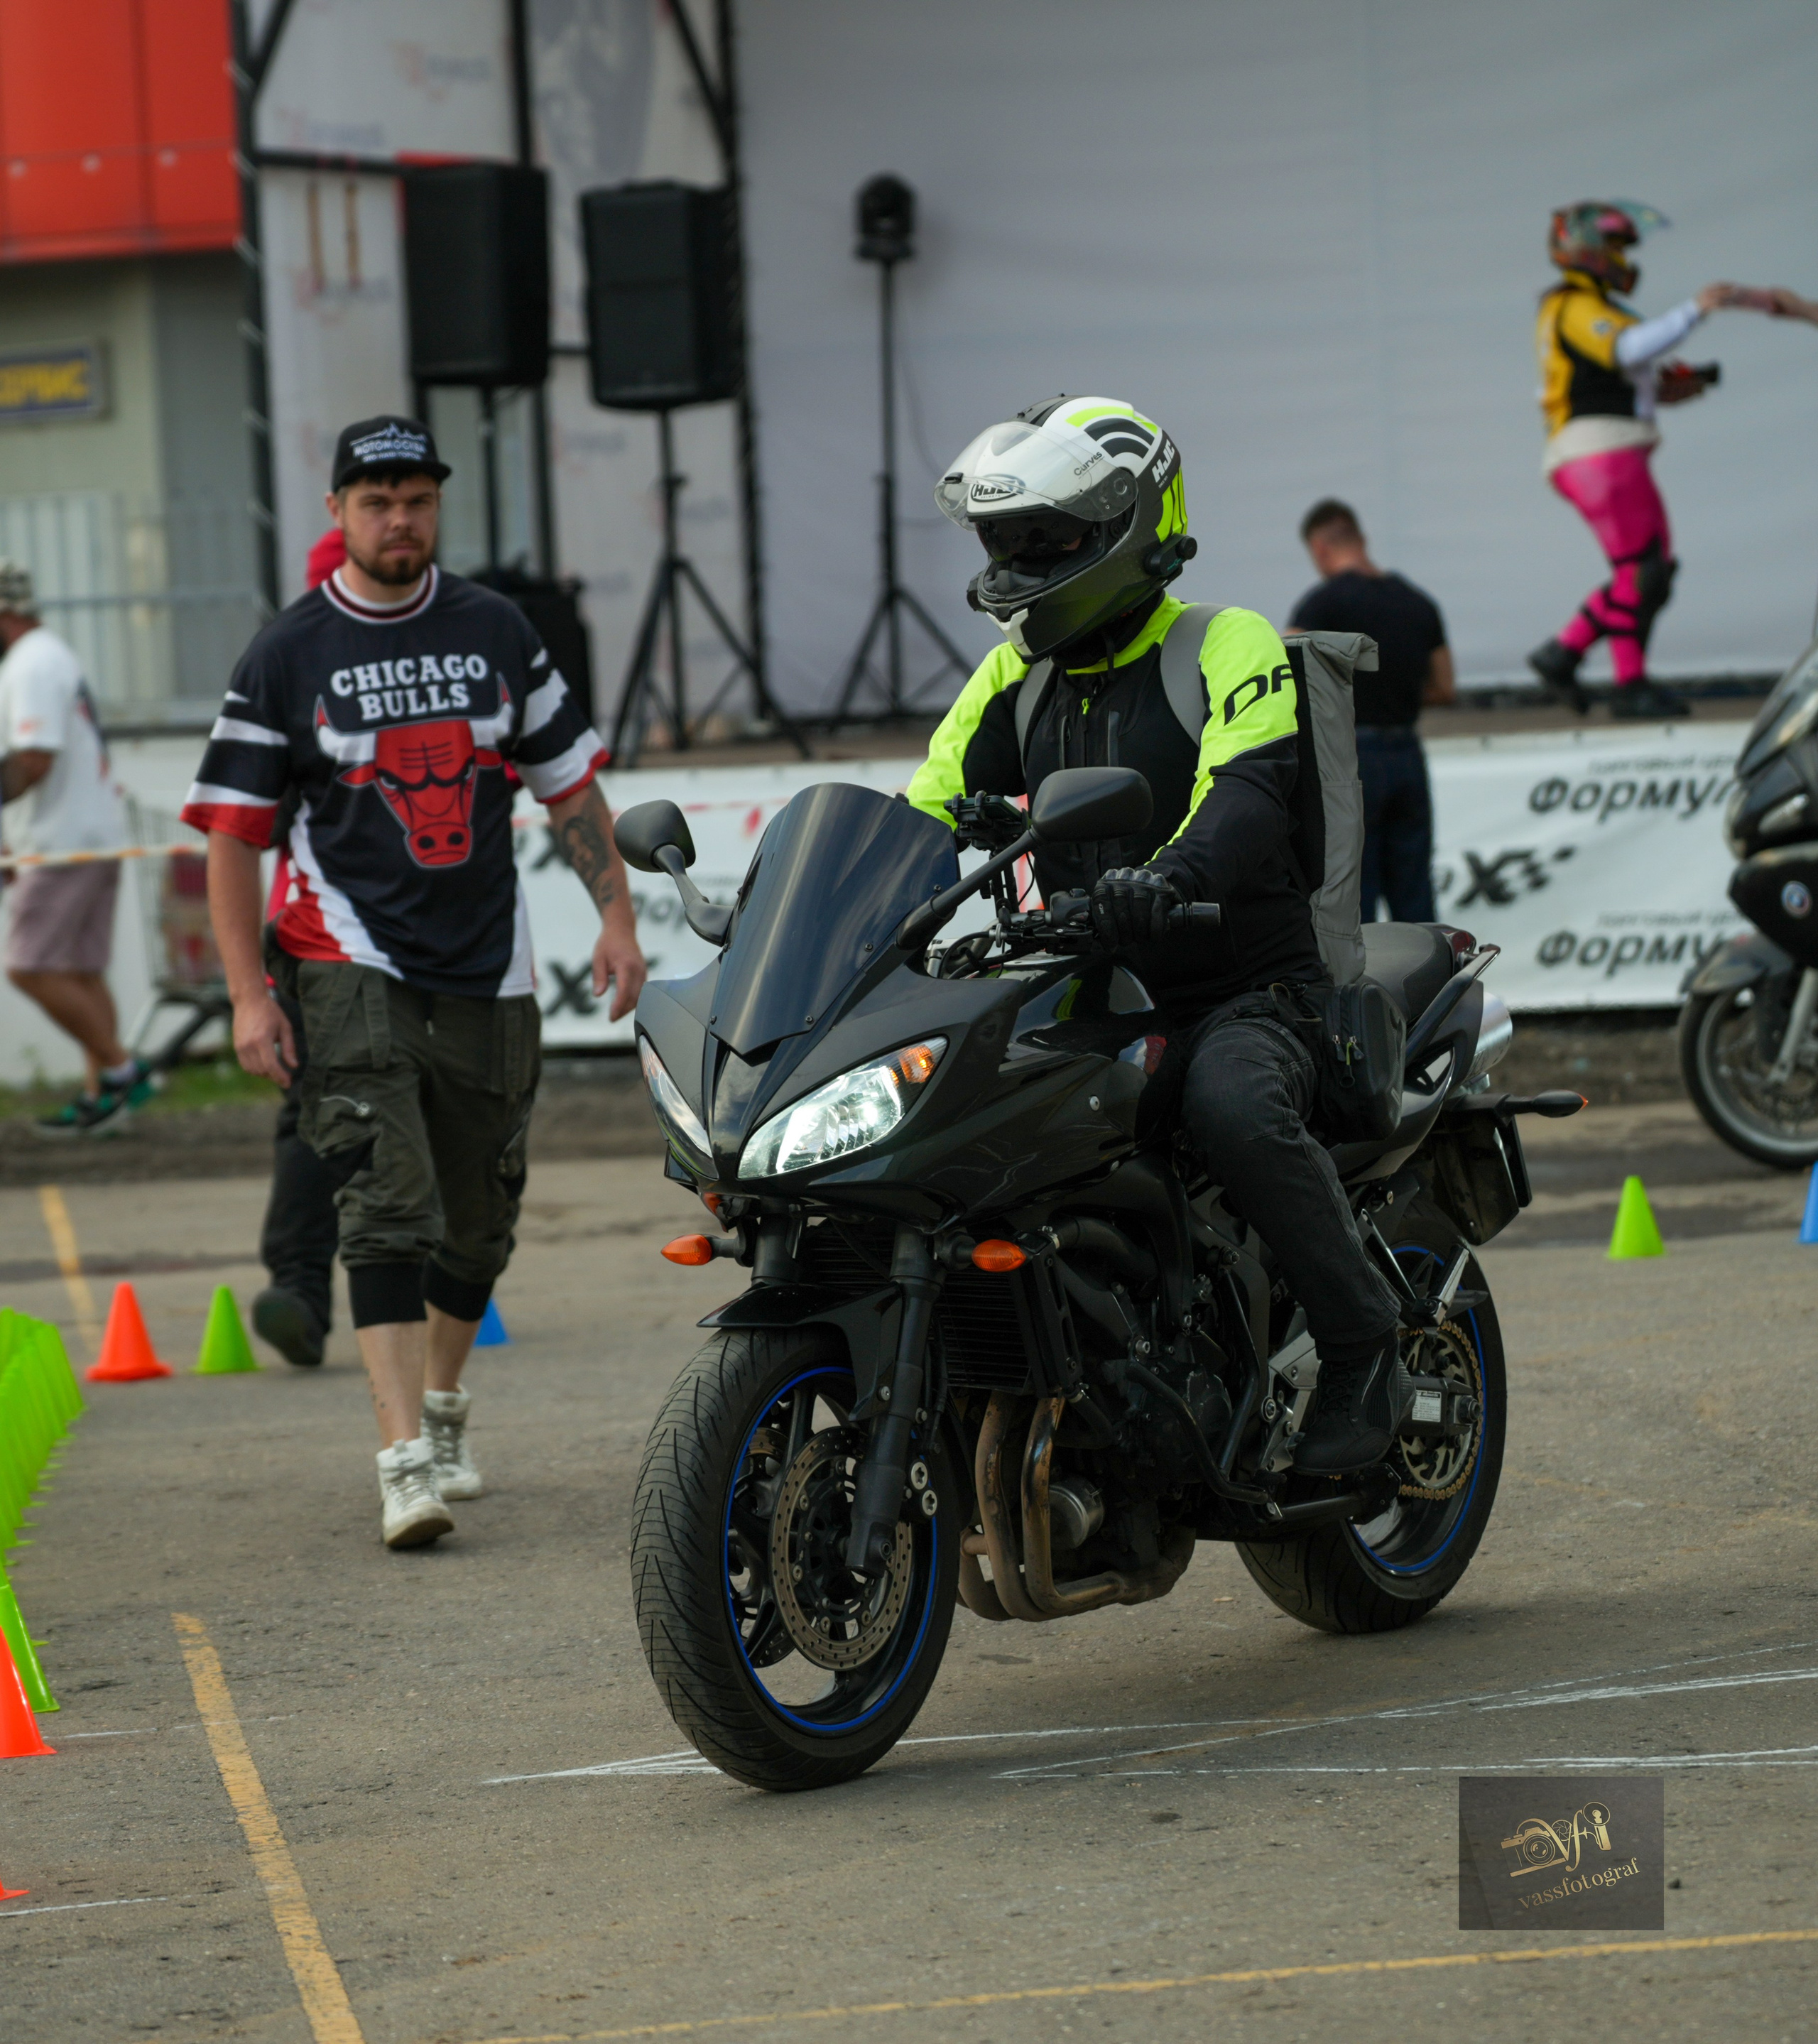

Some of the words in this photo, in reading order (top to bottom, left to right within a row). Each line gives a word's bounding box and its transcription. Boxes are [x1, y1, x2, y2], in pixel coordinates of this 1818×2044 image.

[1152, 439, 1175, 483] HJC
[331, 653, 488, 697] CHICAGO
[358, 683, 470, 721] BULLS
